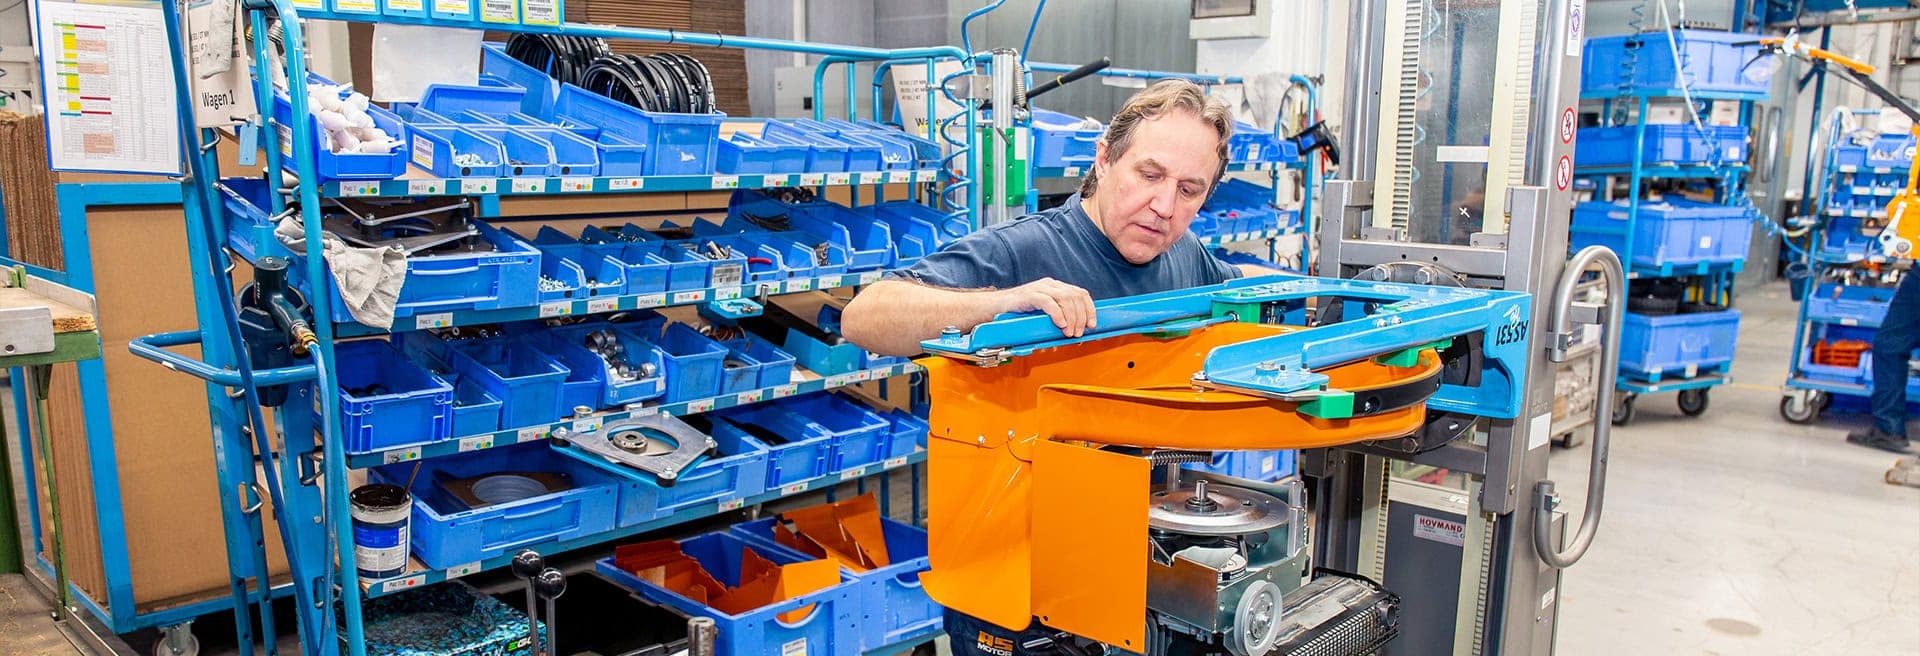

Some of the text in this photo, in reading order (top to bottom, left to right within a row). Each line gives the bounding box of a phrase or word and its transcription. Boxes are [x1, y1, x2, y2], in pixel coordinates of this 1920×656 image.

[202, 89, 235, 110] Wagen 1
[1419, 517, 1463, 533] HOVMAND
[977, 643, 1013, 656] MOTOR
[978, 631, 1014, 651] AS
